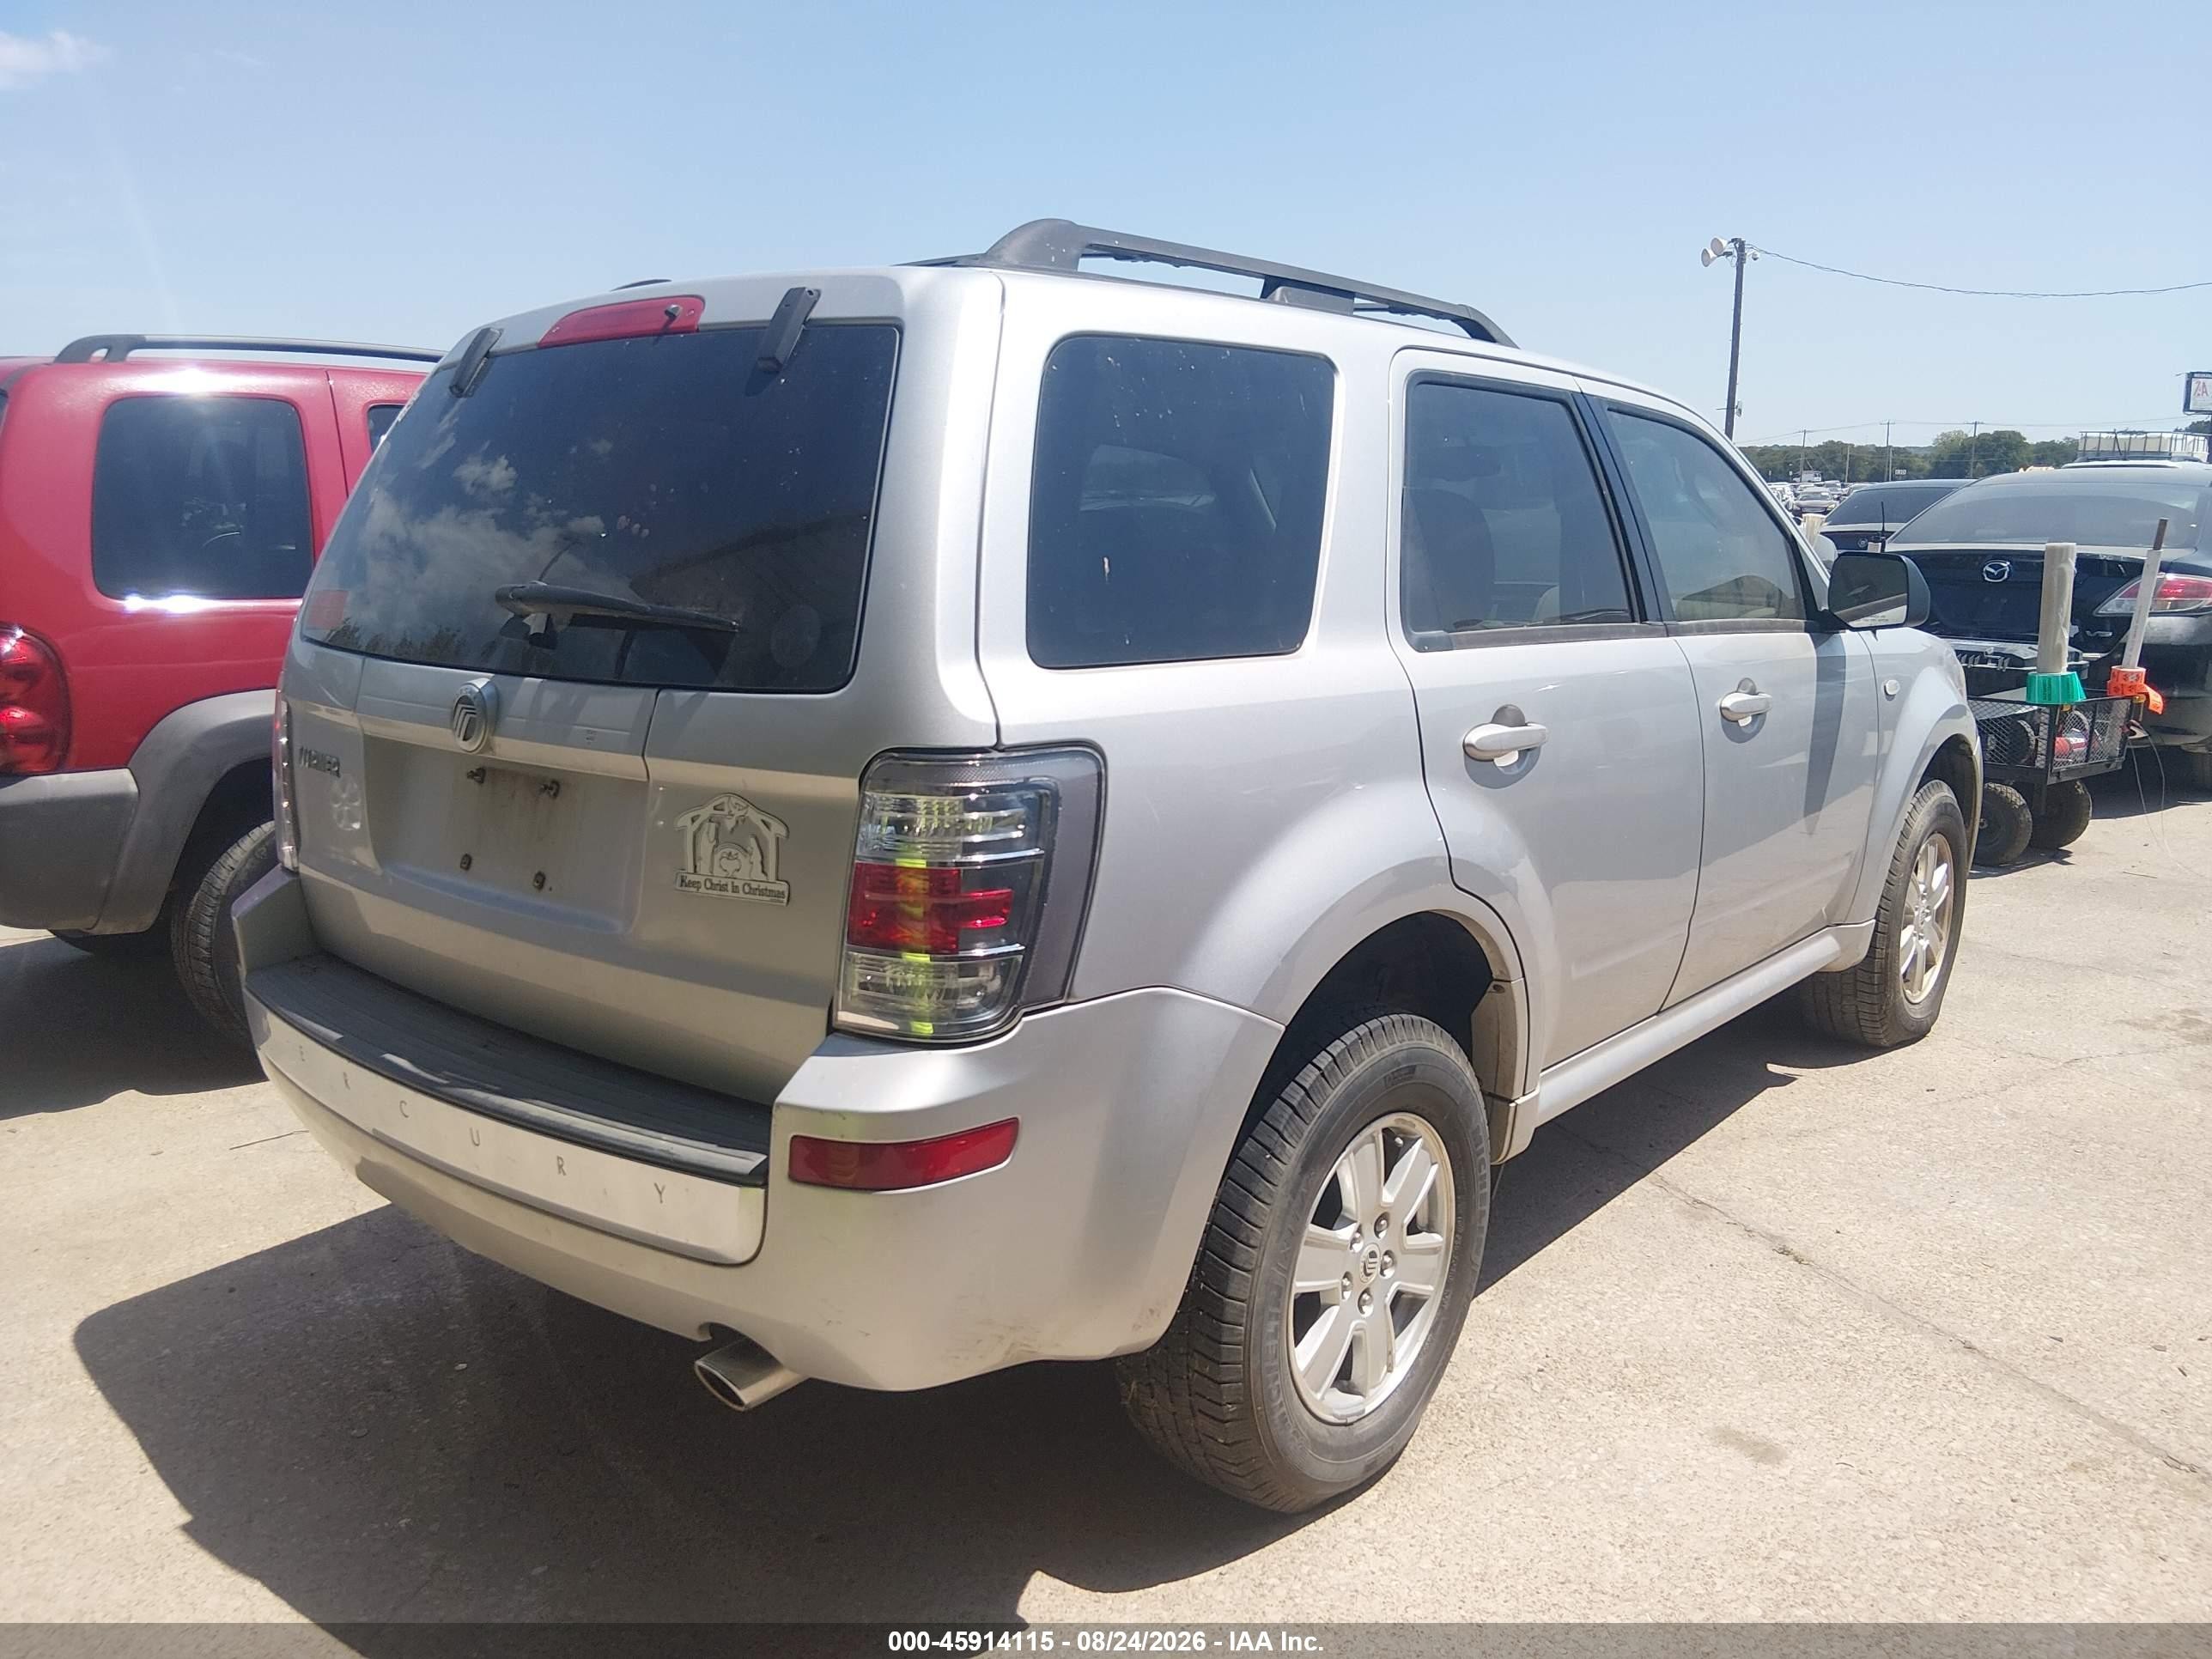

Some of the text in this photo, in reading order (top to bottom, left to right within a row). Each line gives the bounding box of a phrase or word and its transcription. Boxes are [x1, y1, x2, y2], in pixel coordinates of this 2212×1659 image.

[680, 875, 702, 891] Keep
[704, 878, 728, 892] Christ
[742, 883, 786, 898] Christmas
